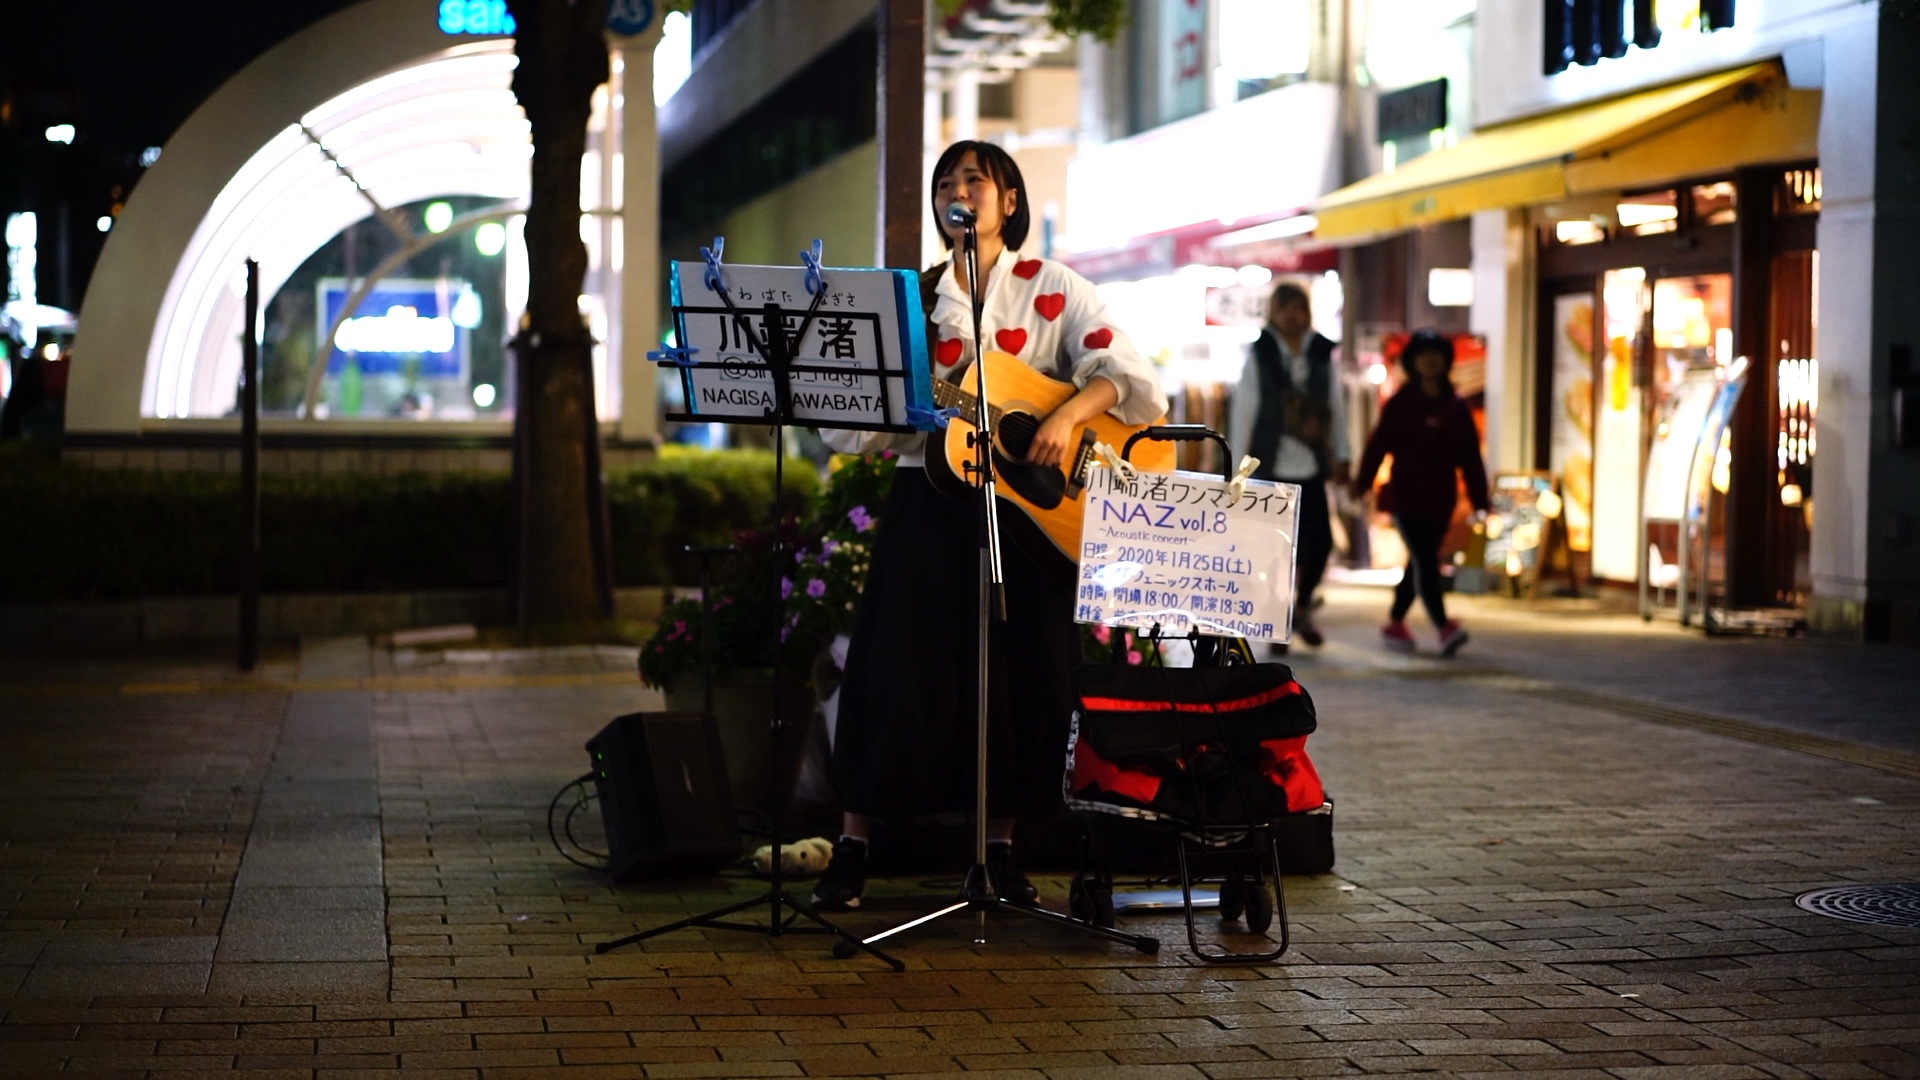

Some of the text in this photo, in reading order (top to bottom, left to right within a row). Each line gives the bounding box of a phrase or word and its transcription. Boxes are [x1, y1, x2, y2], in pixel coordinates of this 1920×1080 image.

[726, 287, 792, 302] わばた
[817, 317, 857, 359] 渚
[703, 388, 884, 412] NAGISA AWABATA
[1180, 510, 1227, 534] vol.8
[1080, 584, 1107, 601] 時間
[1078, 604, 1103, 621] 料金
